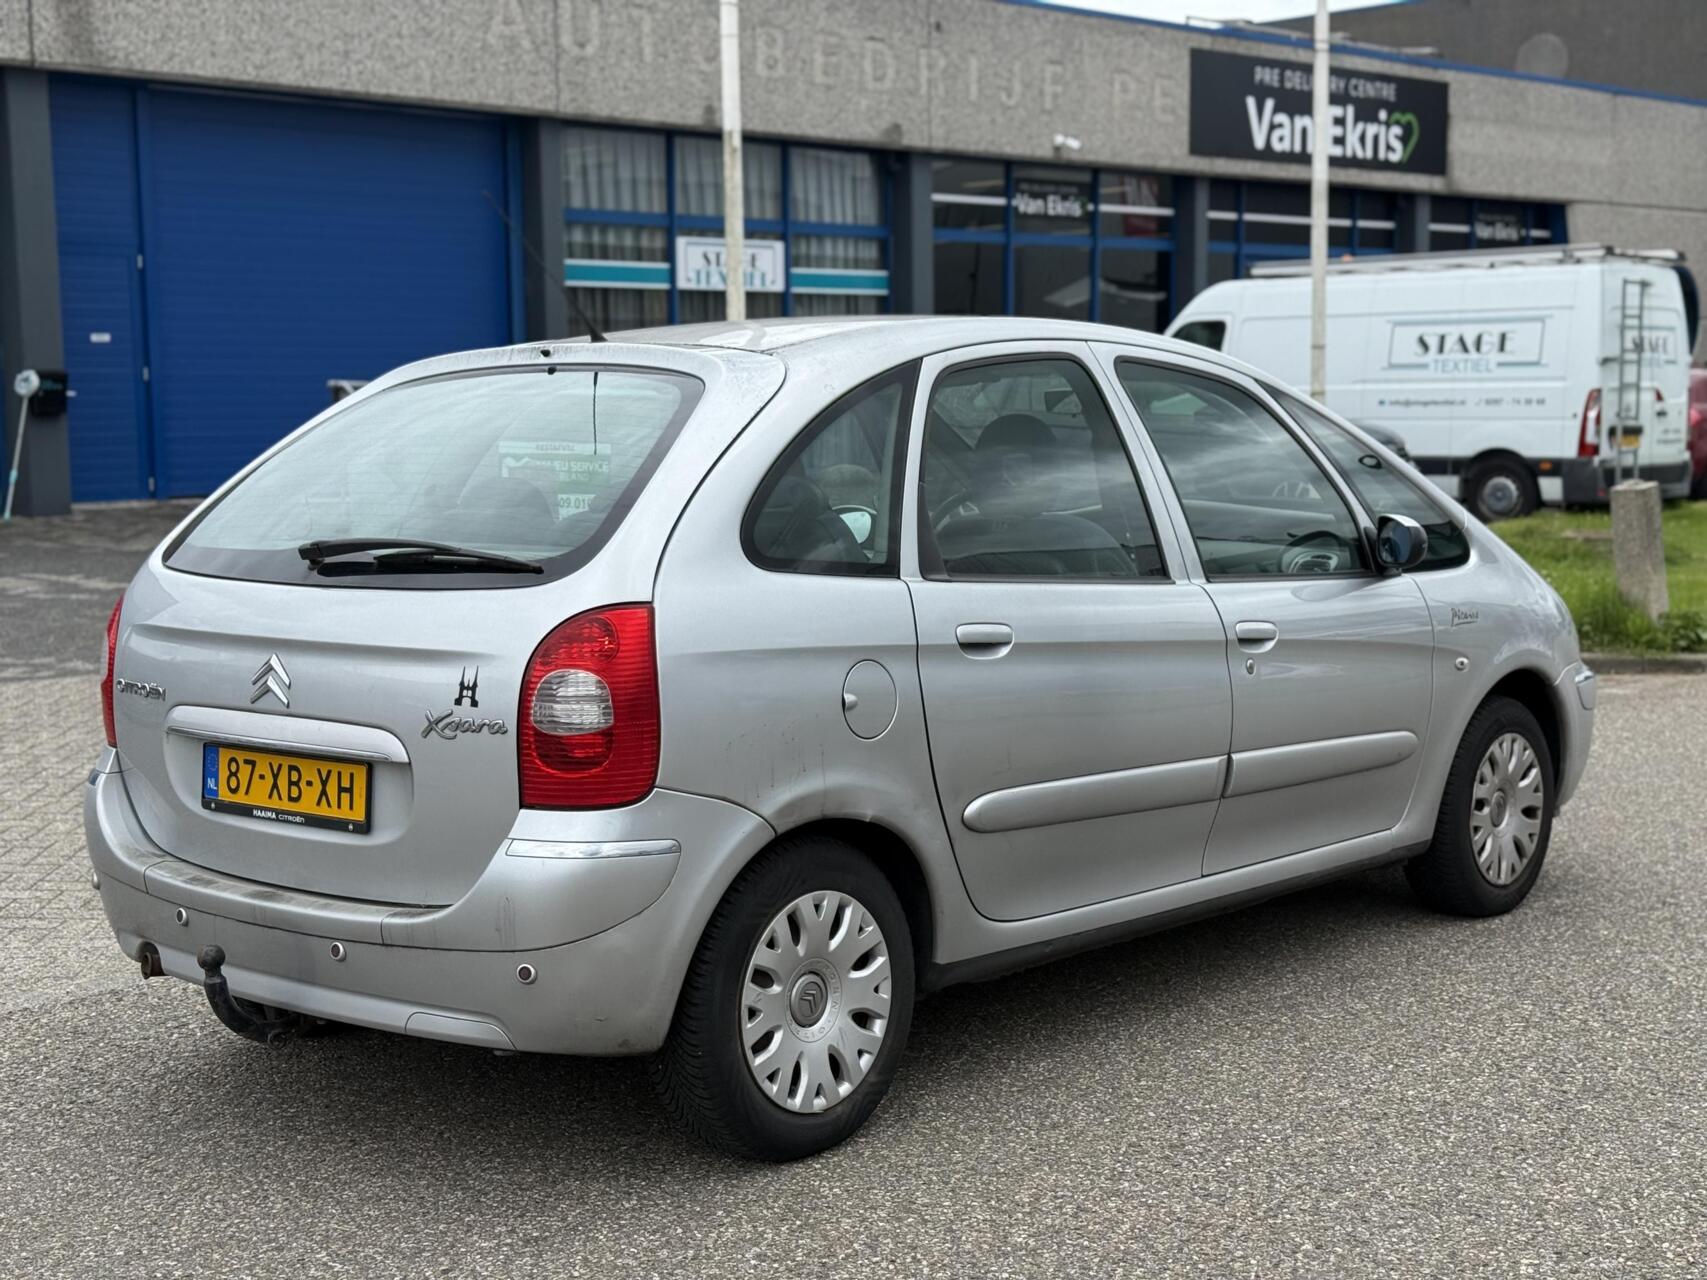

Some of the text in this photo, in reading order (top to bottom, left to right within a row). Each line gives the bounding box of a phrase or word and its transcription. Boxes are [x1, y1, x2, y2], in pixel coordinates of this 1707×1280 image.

[1253, 65, 1398, 102] PRE DELIRY CENTRE
[1245, 95, 1404, 163] Van Ekris
[1015, 192, 1045, 215] Van
[1414, 330, 1516, 357] STAGE
[1431, 357, 1494, 374] TEXTIEL
[570, 461, 609, 473] SERVICE
[116, 678, 167, 701] CITROËN
[421, 709, 508, 740] Xsara
[207, 756, 355, 811] NL 87-XB-XH
[252, 809, 277, 820] HAAIMA
